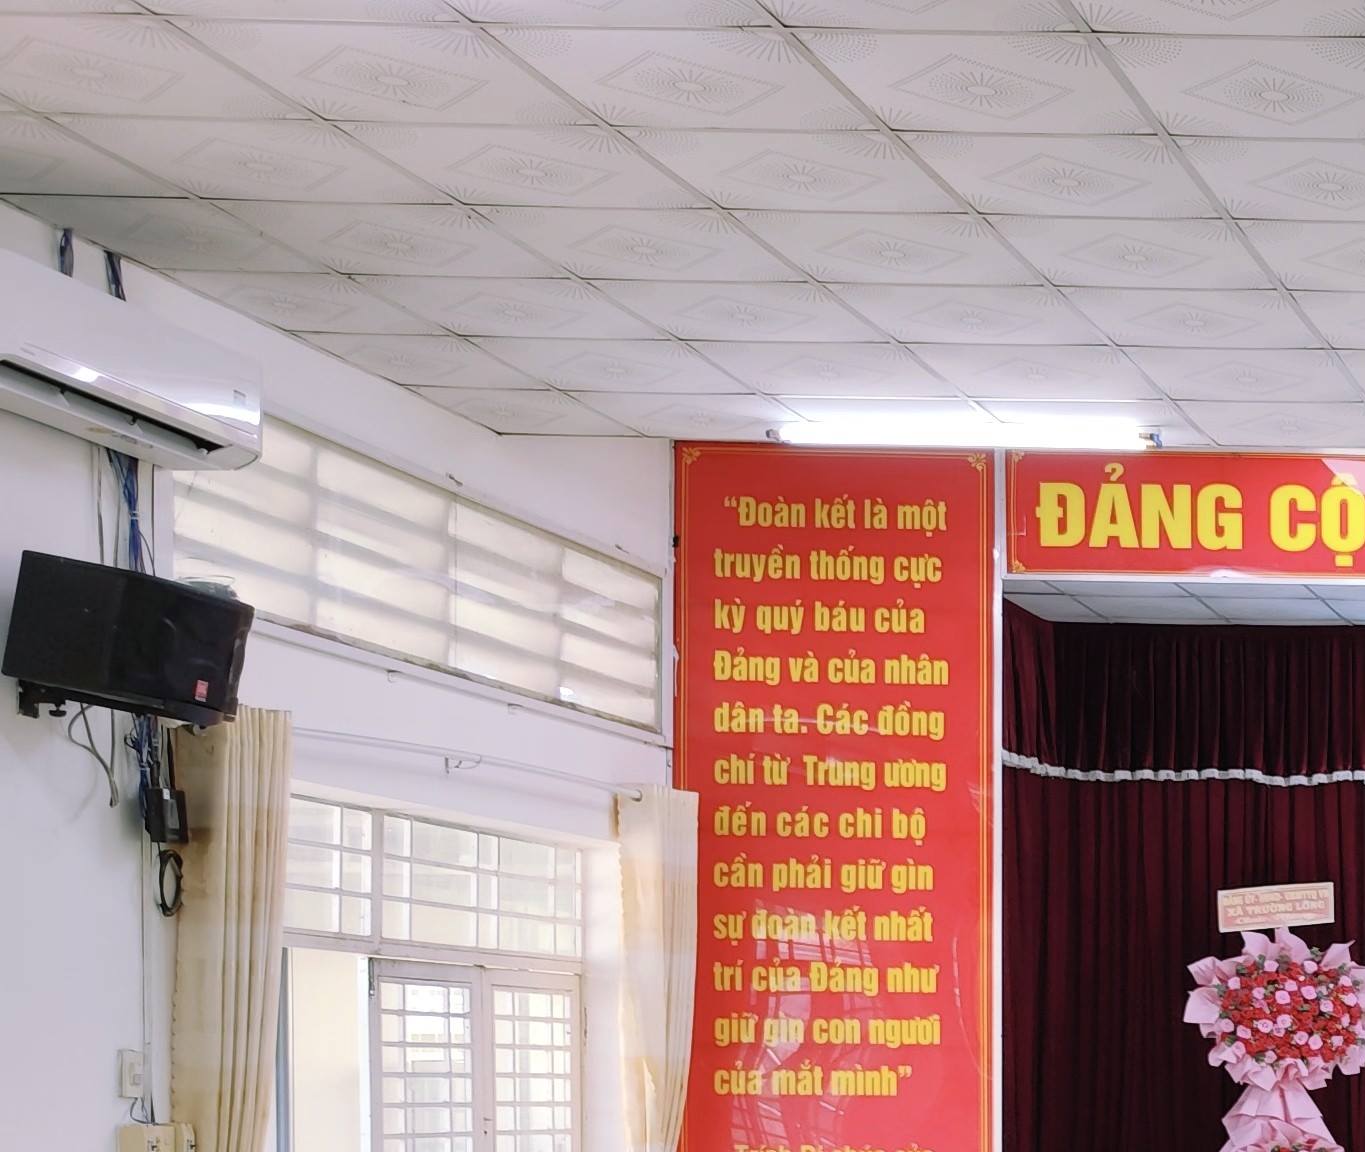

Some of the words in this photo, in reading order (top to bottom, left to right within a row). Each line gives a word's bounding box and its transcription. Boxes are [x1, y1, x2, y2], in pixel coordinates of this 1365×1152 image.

[724, 496, 805, 528] “Đoàn
[815, 494, 855, 529] kết
[864, 497, 887, 529] là
[898, 499, 948, 537] một
[1036, 462, 1244, 550] ĐẢNG
[714, 544, 800, 582] truyền
[810, 546, 884, 584] thống
[894, 554, 942, 588] cực
[714, 598, 745, 632] kỳ
[757, 600, 803, 634] quý
[815, 601, 865, 632] báu
[874, 599, 925, 633] của
[714, 648, 780, 686] Đảng
[789, 651, 819, 682] và
[828, 649, 875, 683] của
[885, 653, 949, 685] nhân
[714, 754, 754, 785] chí
[763, 754, 791, 785] từ
[803, 755, 875, 789] Trung
[884, 758, 946, 791] ương
